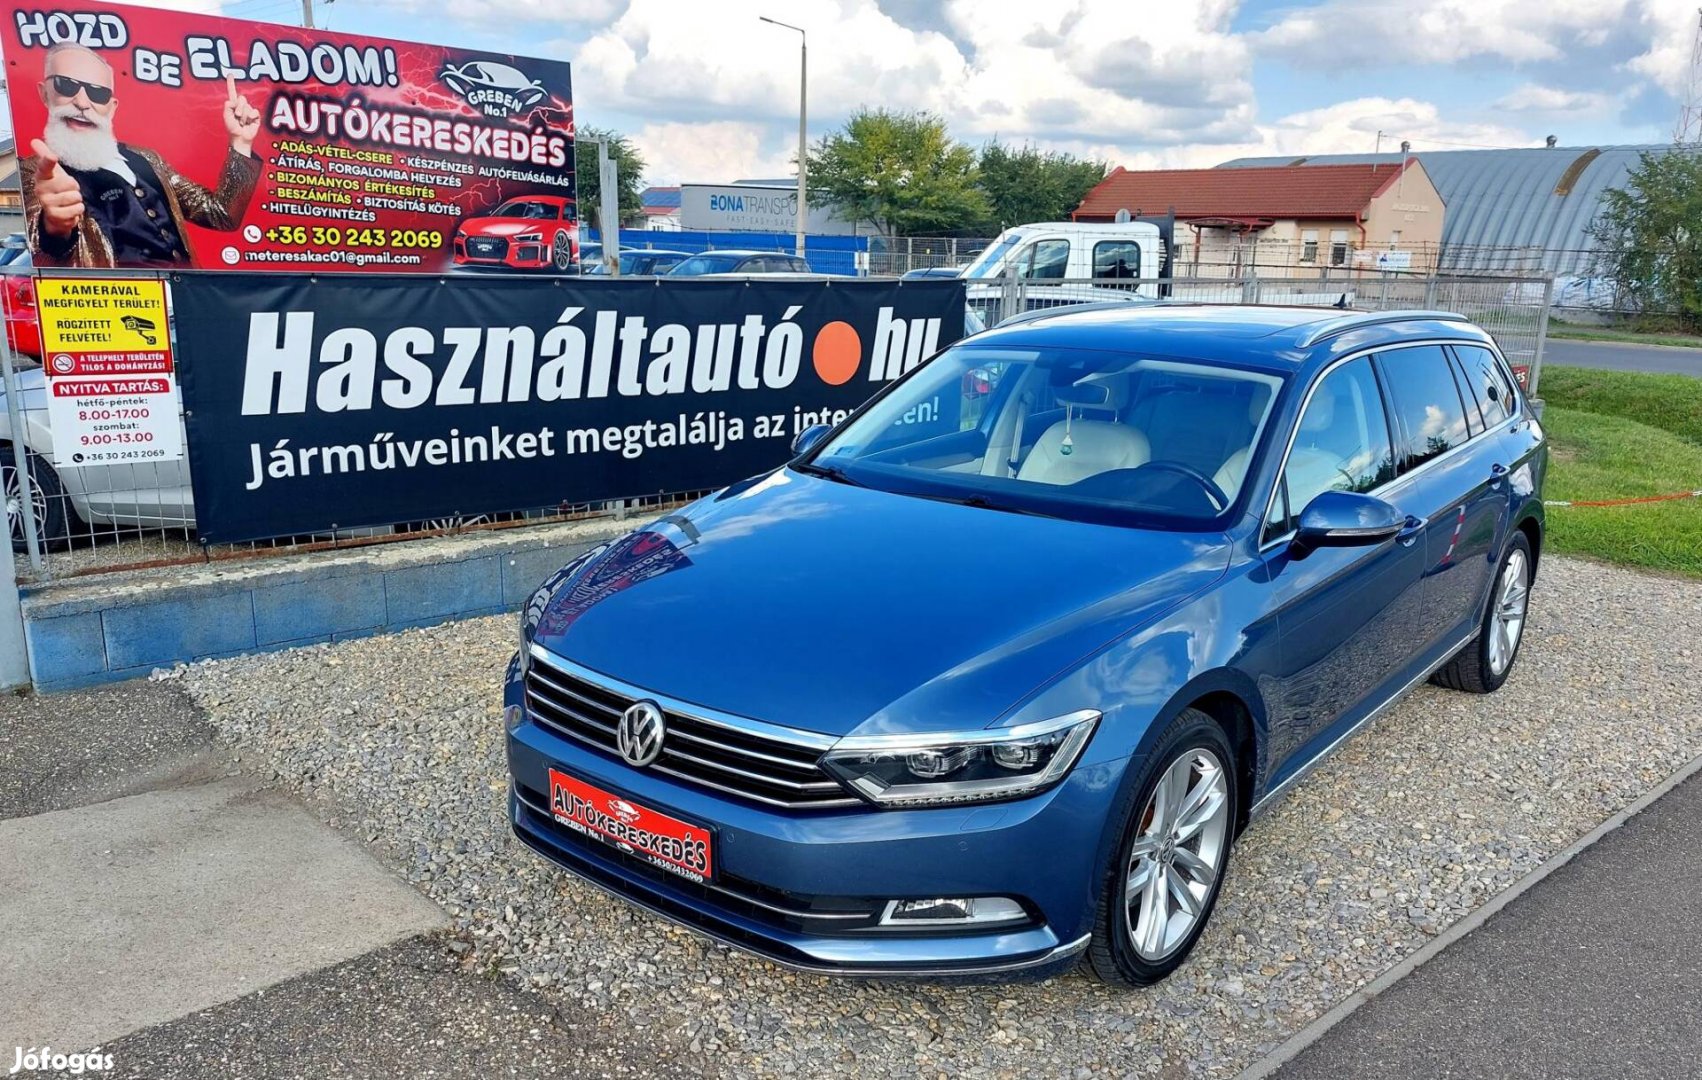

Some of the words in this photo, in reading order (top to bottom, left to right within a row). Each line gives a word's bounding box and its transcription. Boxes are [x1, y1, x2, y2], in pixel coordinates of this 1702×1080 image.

[16, 12, 128, 48] HOZD
[136, 49, 182, 86] BE
[187, 37, 399, 87] ELADOM!
[467, 90, 523, 113] GREBEN
[484, 105, 508, 118] No.1
[272, 97, 566, 167] AUTÓKERESKEDÉS
[280, 142, 394, 165] ADÁS-VÉTEL-CSERE
[277, 155, 325, 173] ÁTÍRÁS,
[328, 162, 409, 181] FORGALOMBA
[410, 172, 462, 188] HELYEZÉS
[407, 157, 475, 175] KÉSZPÉNZES
[478, 166, 570, 188] AUTÓFELVÁSÁRLÁS
[276, 172, 360, 190] BIZOMÁNYOS
[364, 180, 436, 199] ÉRTÉKESÍTÉS
[269, 202, 377, 222] HITELÜGYINTÉZÉS
[277, 188, 352, 205] BESZÁMÍTÁS
[363, 196, 427, 212] BIZTOSÍTÁS
[427, 201, 462, 216] KÖTÉS
[265, 226, 308, 245] +36
[312, 228, 342, 246] 30
[346, 229, 387, 247] 243
[390, 230, 443, 248] 2069
[61, 284, 141, 296] KAMERÁVAL
[43, 298, 109, 309] MEGFIGYELT
[113, 297, 161, 309] TERÜLET!
[56, 318, 112, 330] RÖGZÍTETT
[59, 332, 112, 343] FELVÉTEL!
[81, 363, 105, 372] TILOS
[106, 363, 113, 371] A
[114, 361, 166, 371] DOHÁNYZÁS!
[86, 354, 125, 362] TELEPHELY
[126, 352, 165, 361] TERÜLETÉN
[241, 305, 803, 416] Használtautó
[59, 382, 111, 395] NYITVA
[112, 380, 164, 393] TARTÁS:
[78, 408, 150, 422] 8.00-17.00
[93, 422, 140, 432] szombat:
[80, 432, 154, 446] 9.00-13.00
[86, 453, 104, 461] +36
[106, 452, 119, 461] 30
[121, 451, 139, 460] 243
[141, 449, 165, 460] 2069
[246, 424, 554, 490] Járműveinket
[566, 411, 744, 459] megtalálja
[752, 413, 786, 439] az
[554, 783, 707, 872] AUTÓKERESKEDÉS
